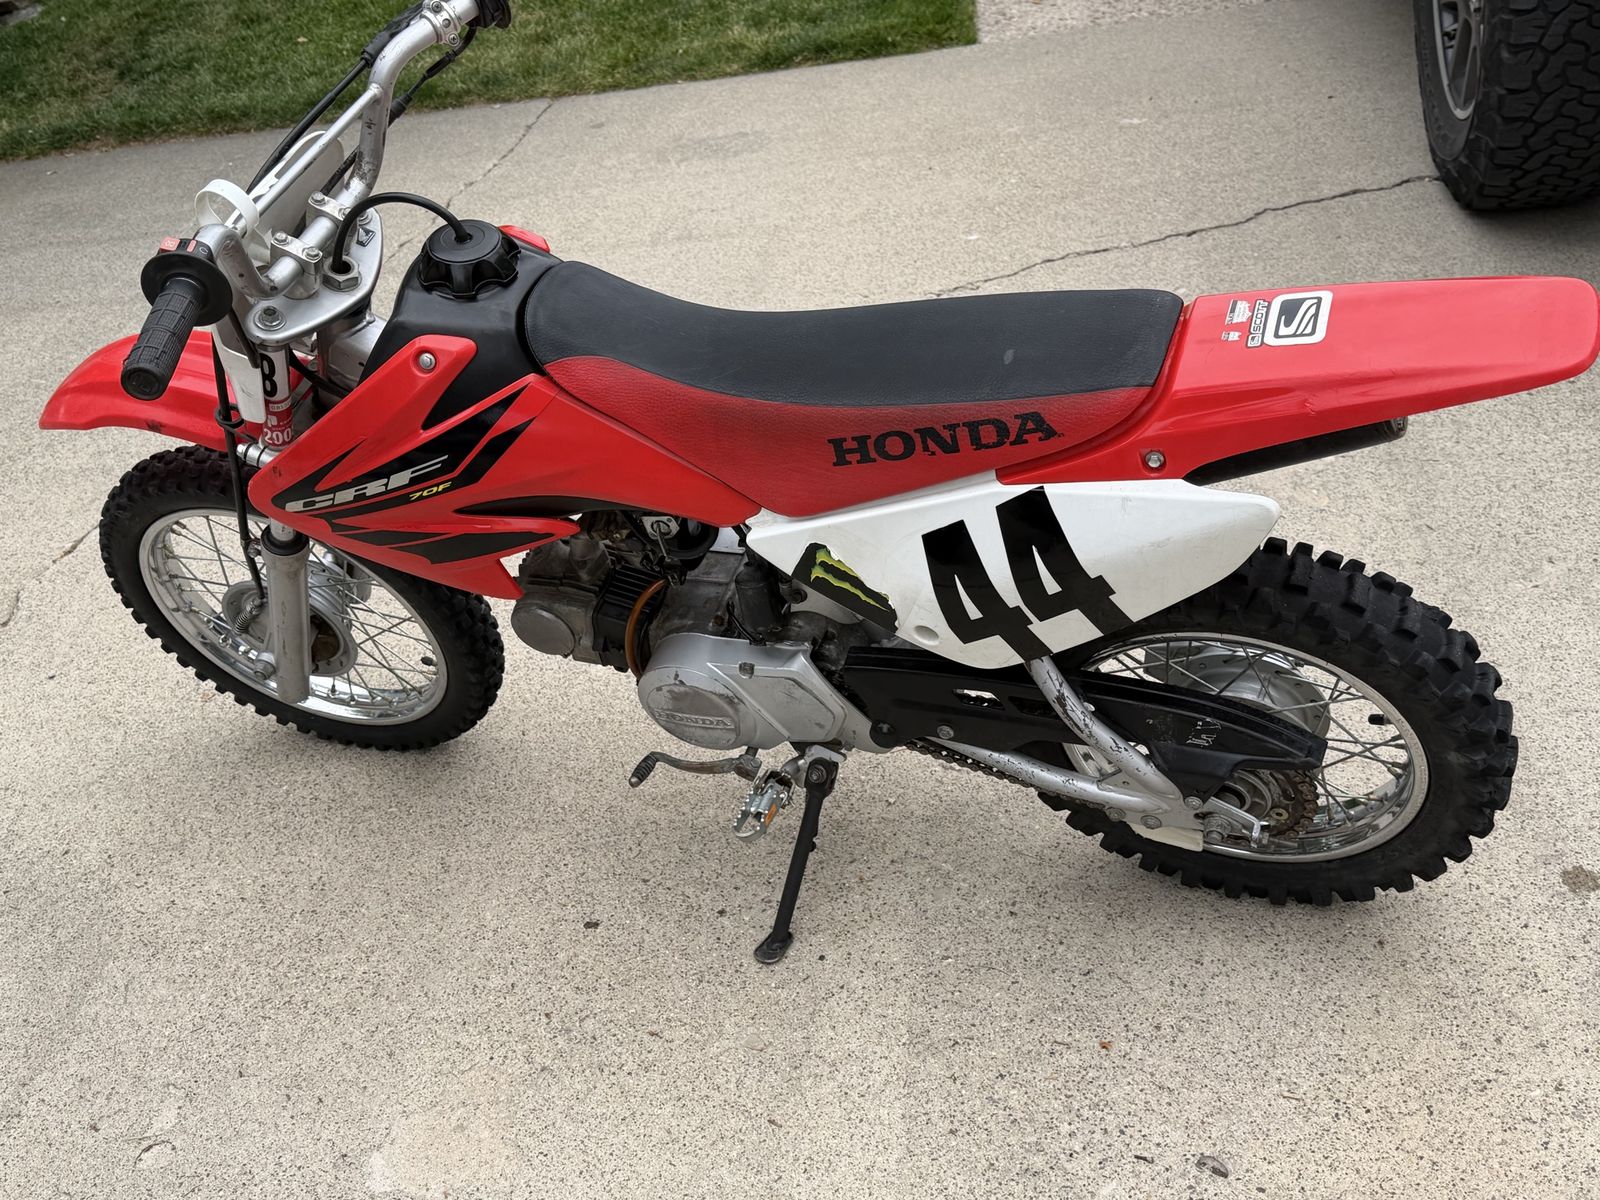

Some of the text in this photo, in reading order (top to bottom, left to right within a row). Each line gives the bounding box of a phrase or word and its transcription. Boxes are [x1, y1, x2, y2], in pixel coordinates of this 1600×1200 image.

[1252, 301, 1269, 333] SCOTT
[827, 411, 1059, 466] HONDA
[285, 454, 449, 513] CRF
[409, 481, 452, 501] 70F
[921, 485, 1135, 664] 44
